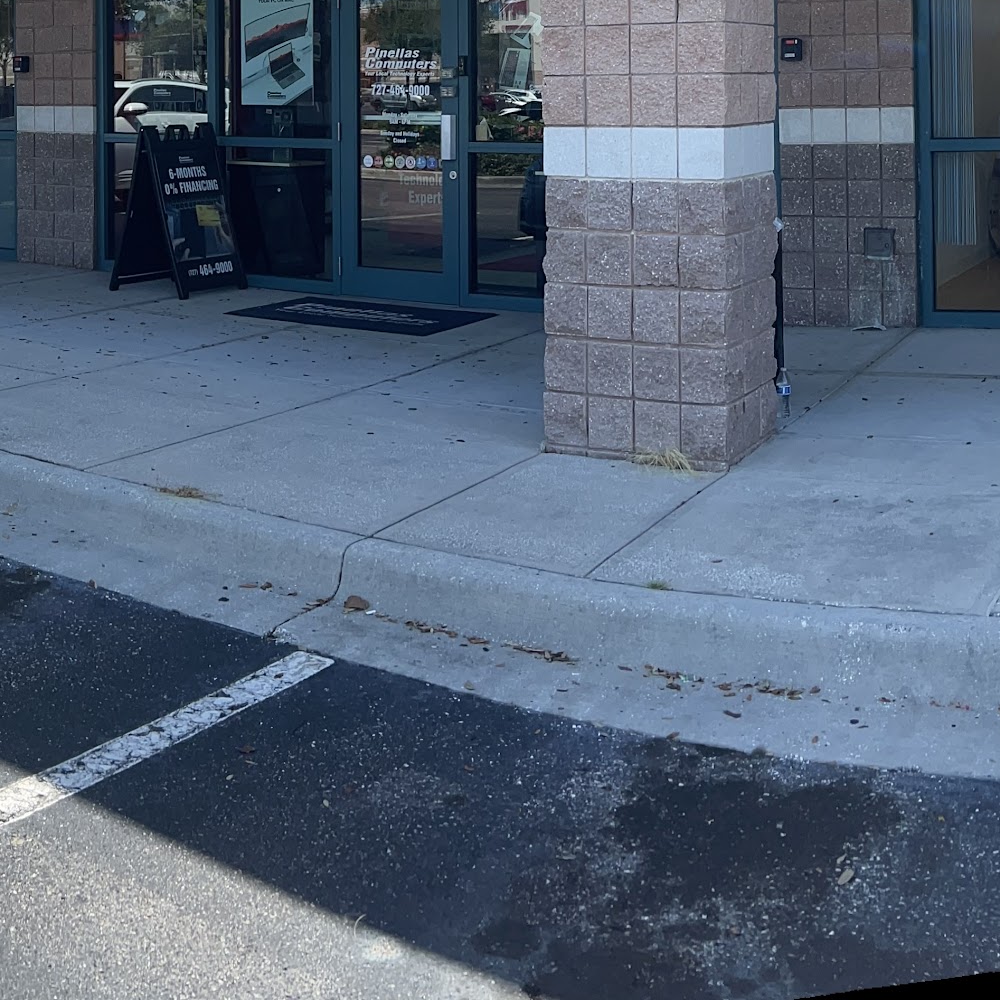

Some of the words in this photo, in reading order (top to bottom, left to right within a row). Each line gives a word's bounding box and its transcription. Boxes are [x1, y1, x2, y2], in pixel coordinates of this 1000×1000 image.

[365, 46, 420, 58] Pinellas
[365, 57, 437, 70] Computers
[168, 165, 207, 179] 6-MONTHS
[164, 182, 178, 195] 0%
[179, 179, 219, 194] FINANCING
[408, 191, 443, 205] Expert
[199, 260, 233, 277] 464-9000
